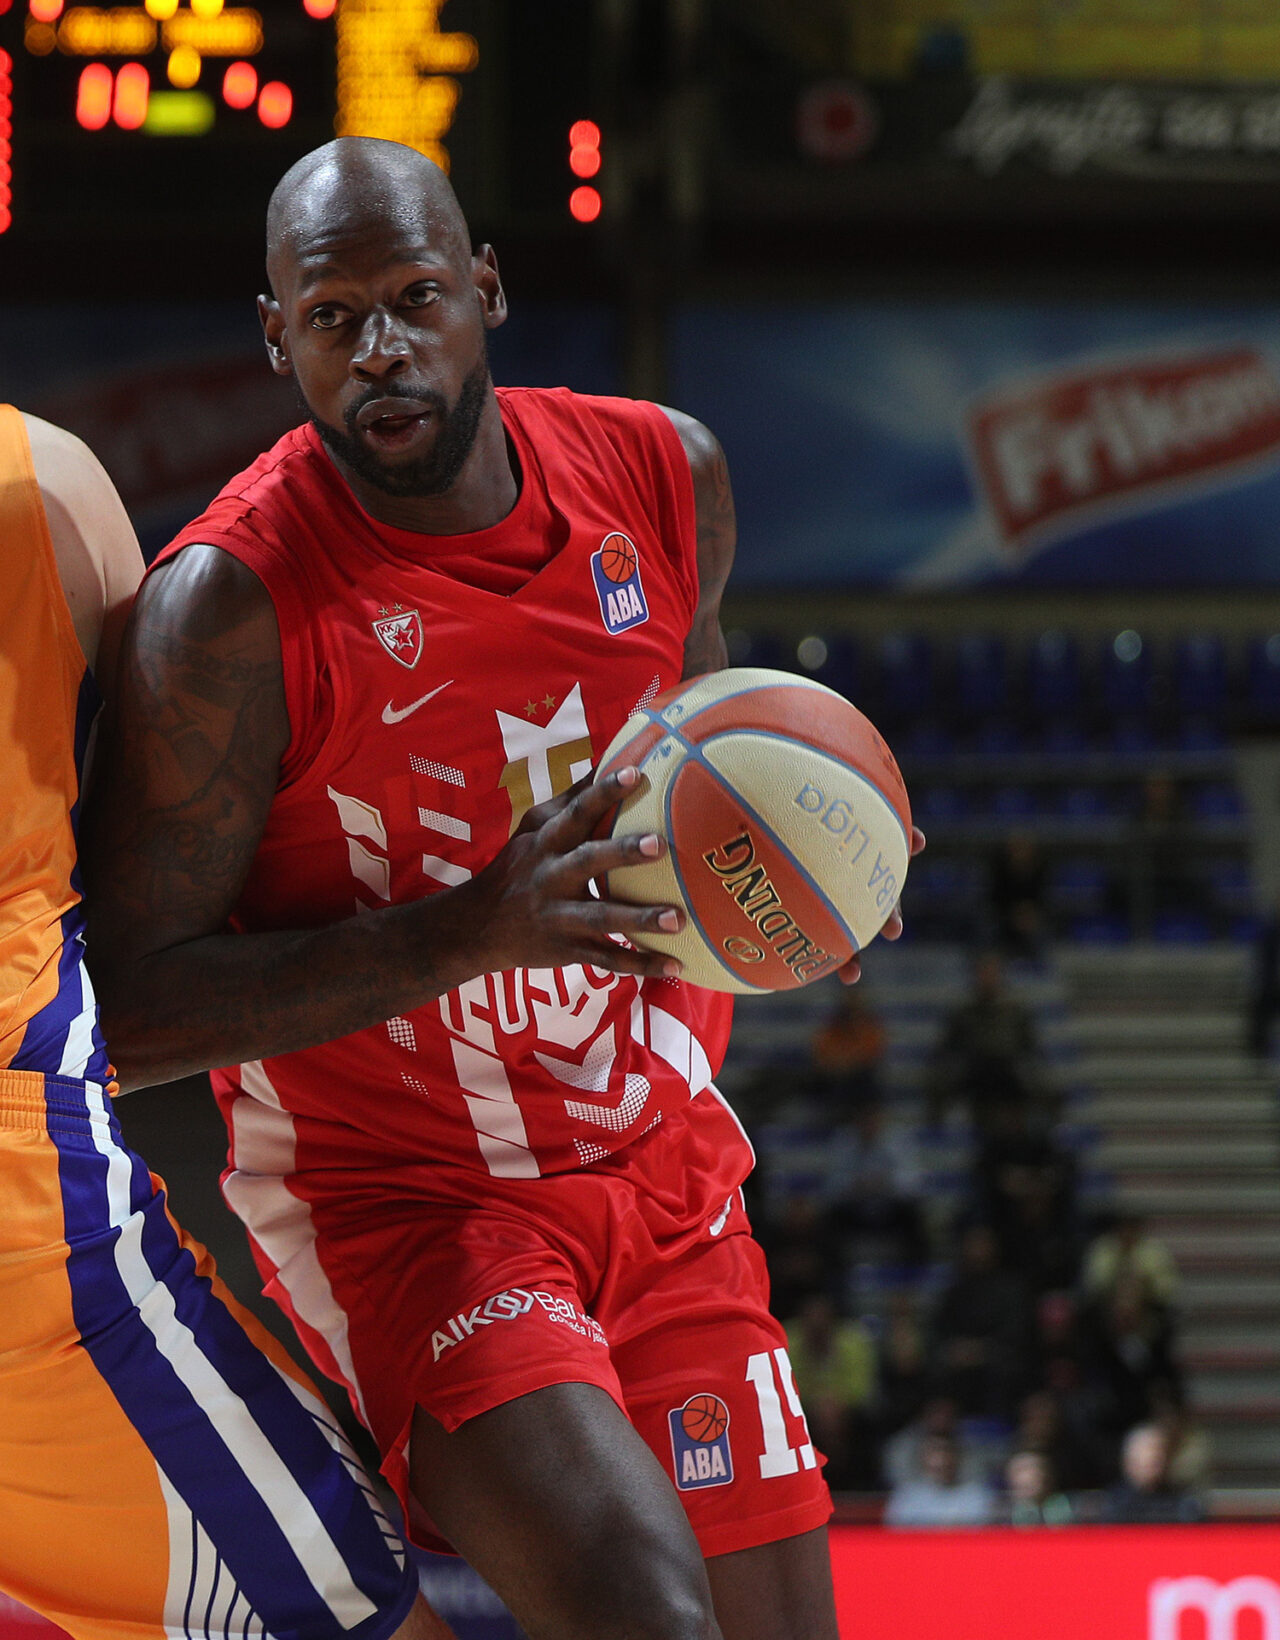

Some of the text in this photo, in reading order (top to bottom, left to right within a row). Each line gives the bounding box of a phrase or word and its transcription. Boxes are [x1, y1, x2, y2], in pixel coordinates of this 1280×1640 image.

[606, 584, 644, 627] ABA
[702, 830, 844, 984] PALDING
[867, 851, 899, 918] BA
[682, 1444, 727, 1483] ABA
